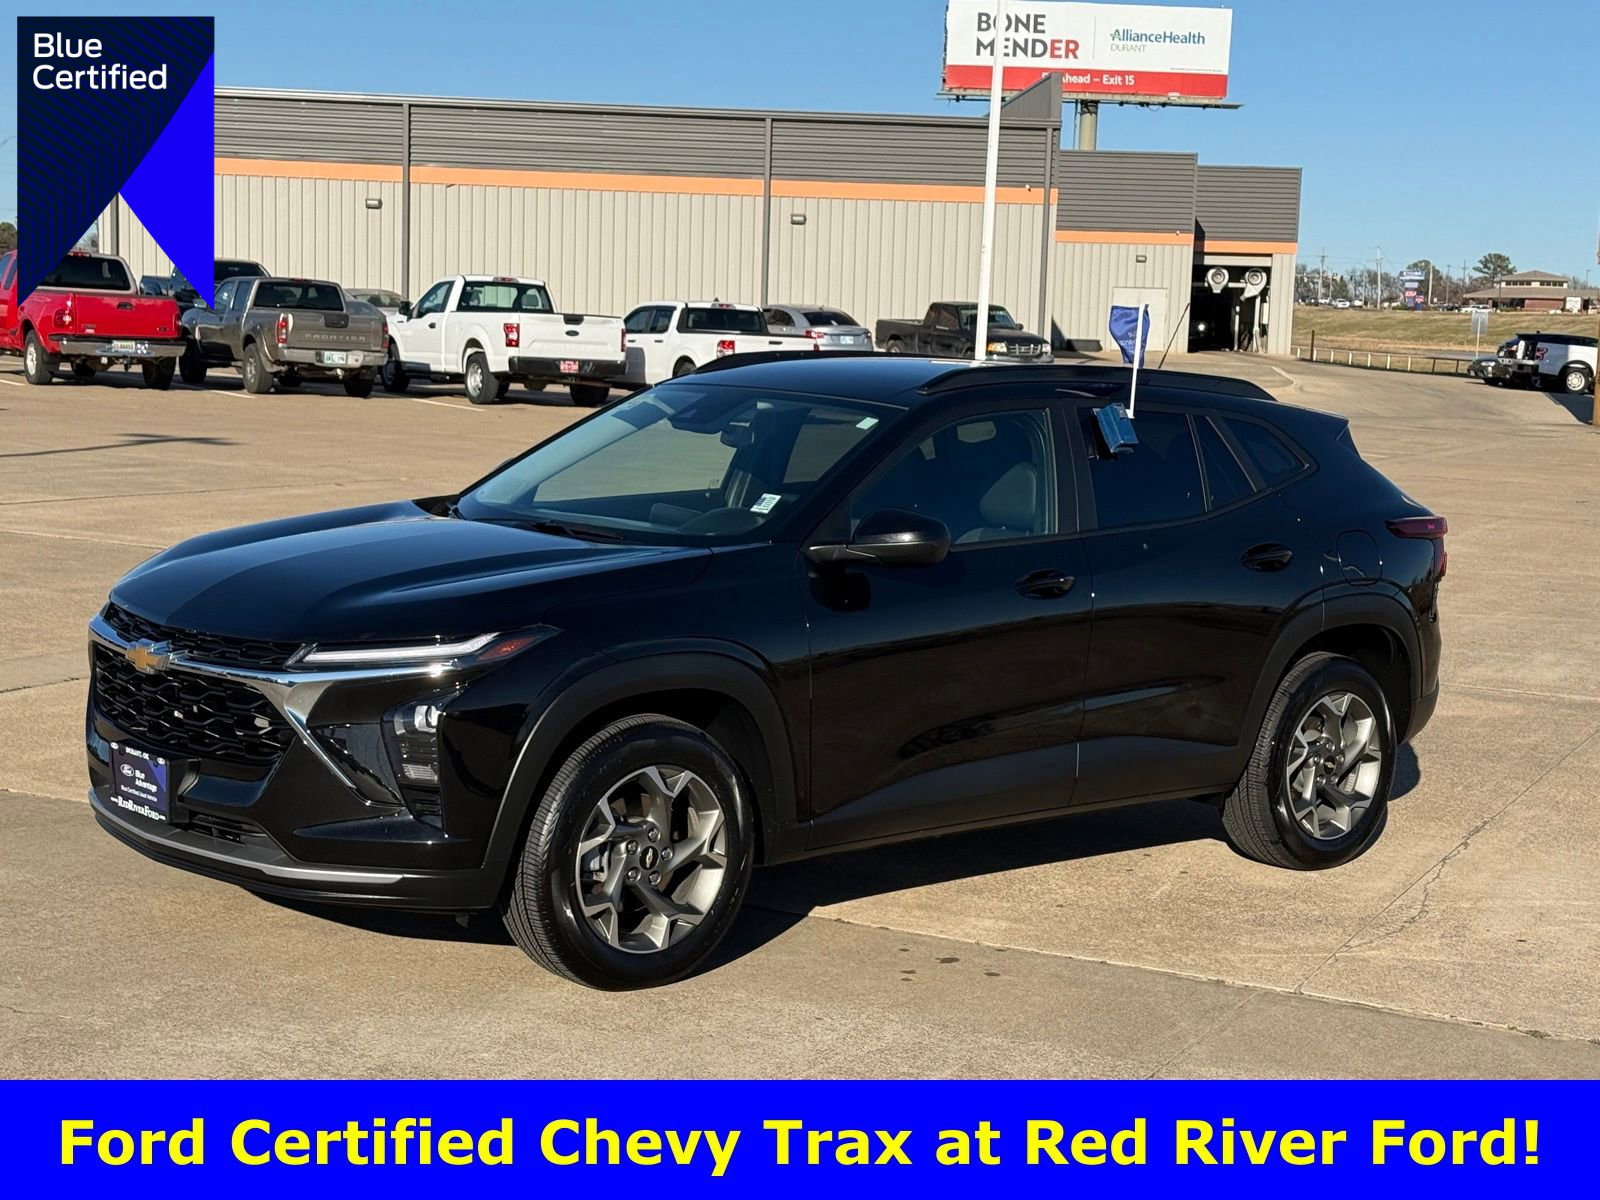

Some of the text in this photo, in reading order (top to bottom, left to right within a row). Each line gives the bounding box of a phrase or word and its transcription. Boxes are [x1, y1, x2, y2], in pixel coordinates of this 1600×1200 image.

[977, 12, 1046, 34] BONE
[1110, 28, 1205, 45] AllianceHealth
[1110, 43, 1146, 53] DURANT
[1102, 74, 1122, 85] Exit
[1125, 75, 1135, 86] 15
[305, 333, 366, 342] FRONTIER
